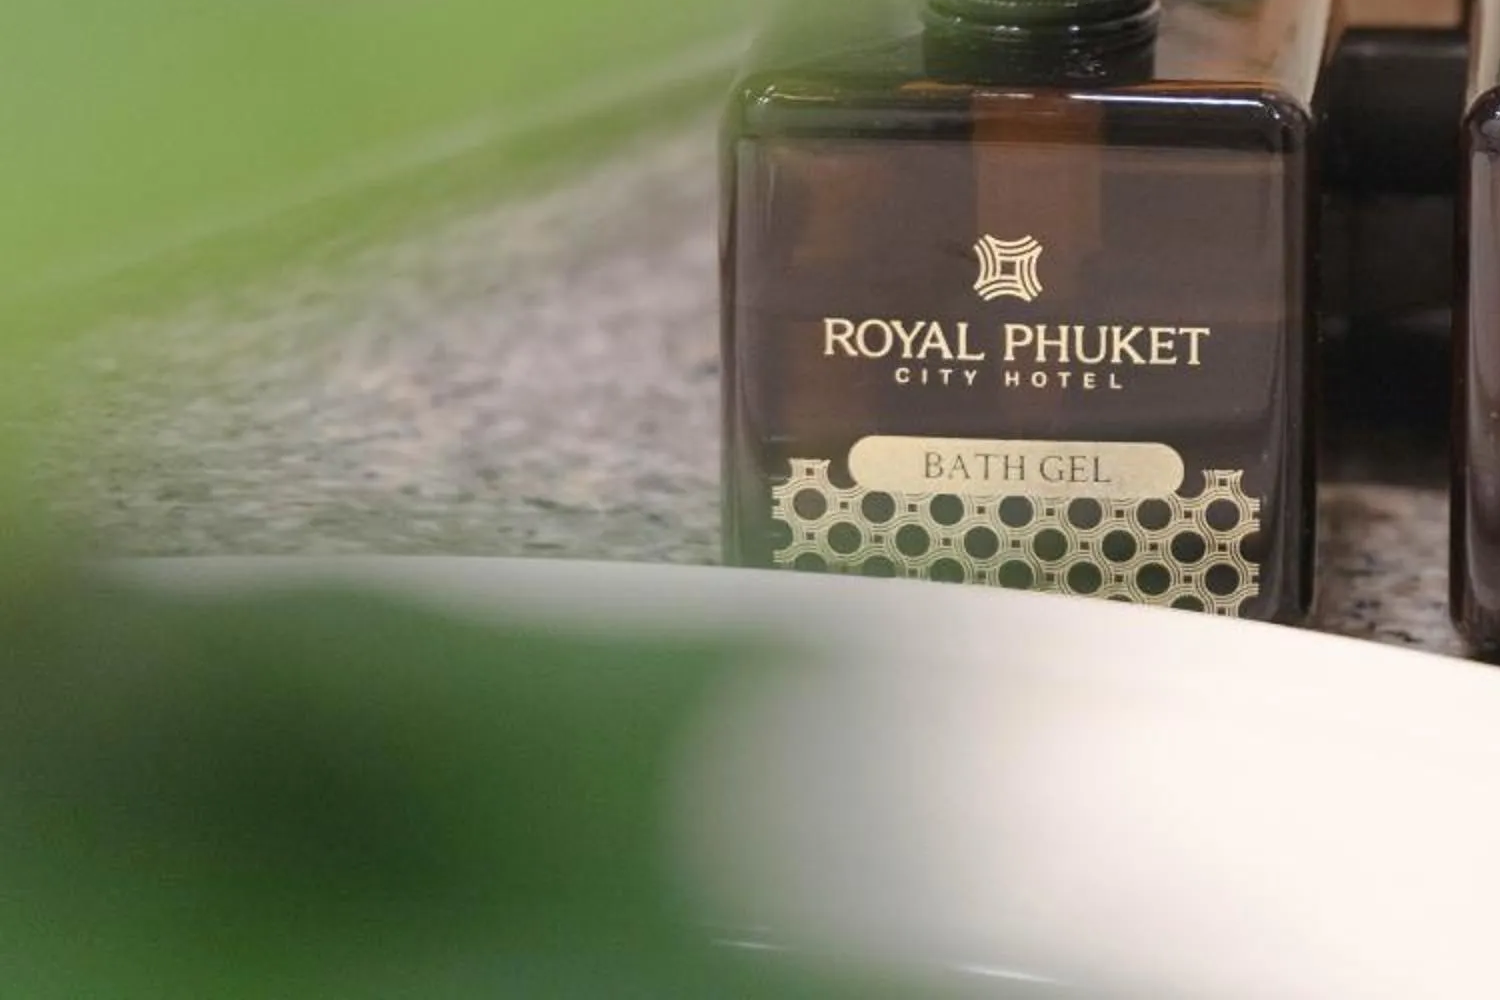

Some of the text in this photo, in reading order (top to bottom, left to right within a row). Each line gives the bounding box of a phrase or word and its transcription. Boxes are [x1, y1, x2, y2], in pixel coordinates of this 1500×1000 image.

[823, 317, 1211, 366] ROYAL PHUKET
[894, 366, 1124, 390] CITY HOTEL
[924, 451, 1113, 485] BATH GEL
